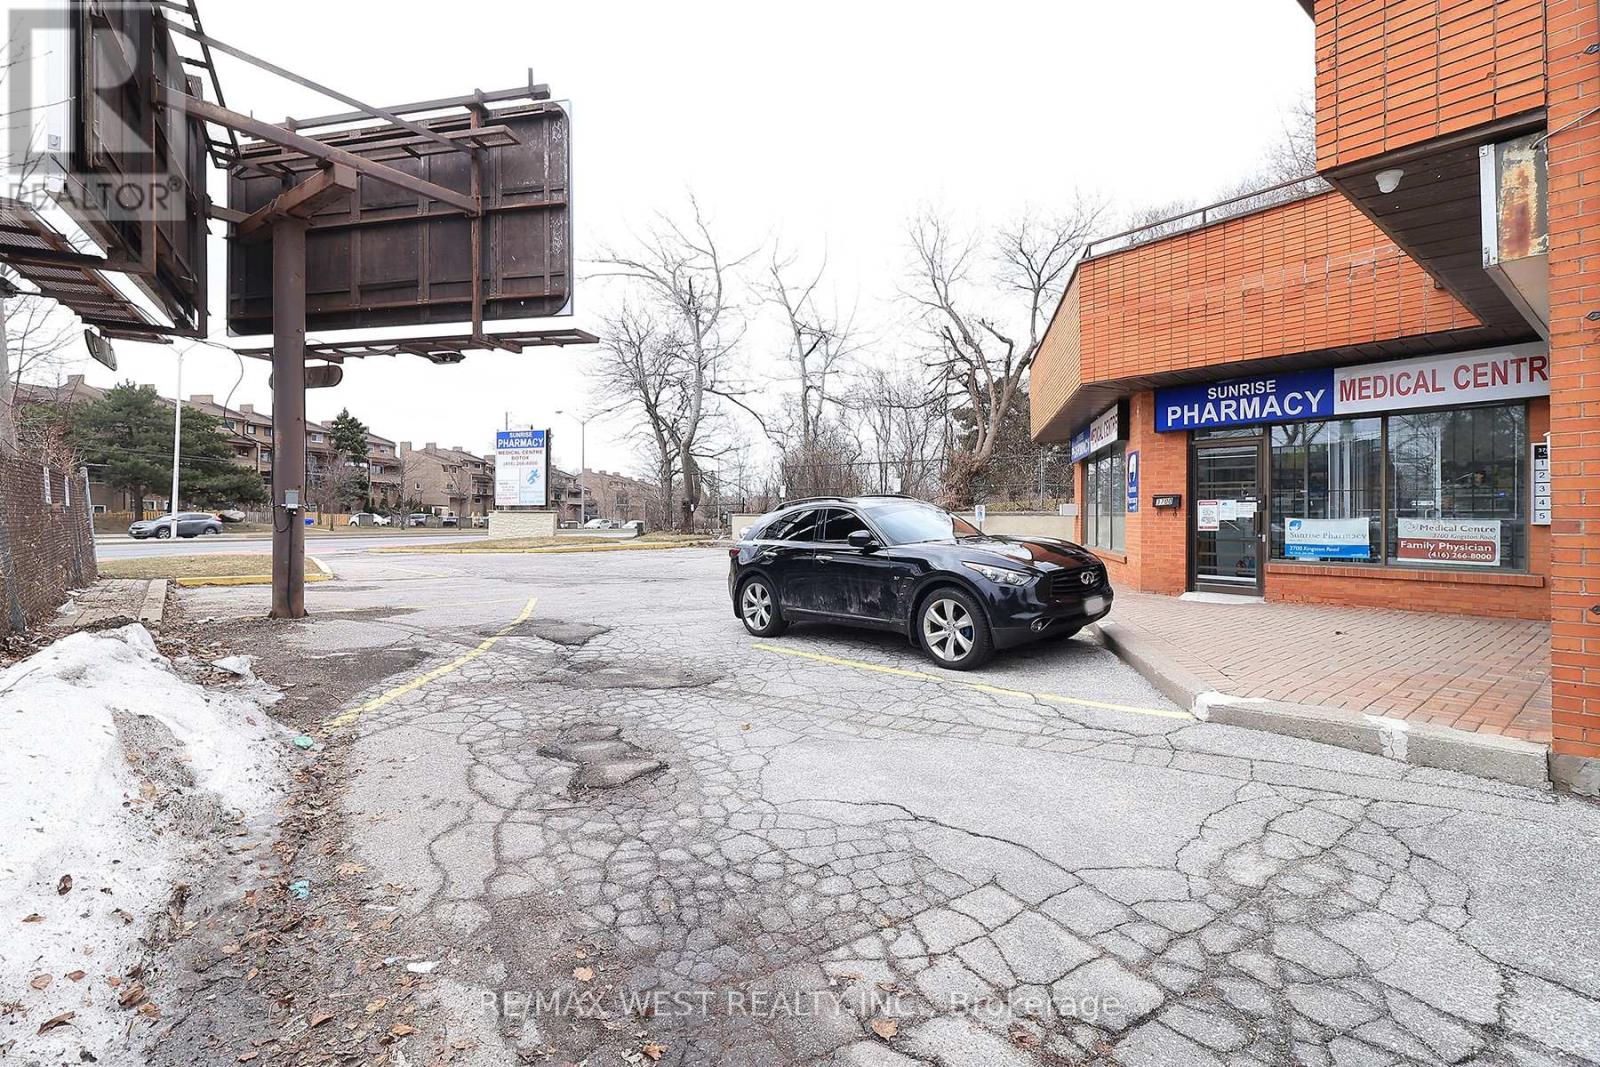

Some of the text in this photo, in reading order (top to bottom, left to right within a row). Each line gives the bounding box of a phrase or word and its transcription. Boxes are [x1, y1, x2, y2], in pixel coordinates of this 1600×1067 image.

[1207, 379, 1277, 400] SUNRISE
[1339, 368, 1446, 402] MEDICAL
[1167, 389, 1325, 427] PHARMACY
[498, 438, 543, 447] PHARMACY
[1460, 525, 1496, 533] Centre
[1289, 531, 1367, 540] Sunrise Pharmacy
[1400, 541, 1492, 552] Family Physician
[1428, 551, 1492, 560] (416) 266-8000
